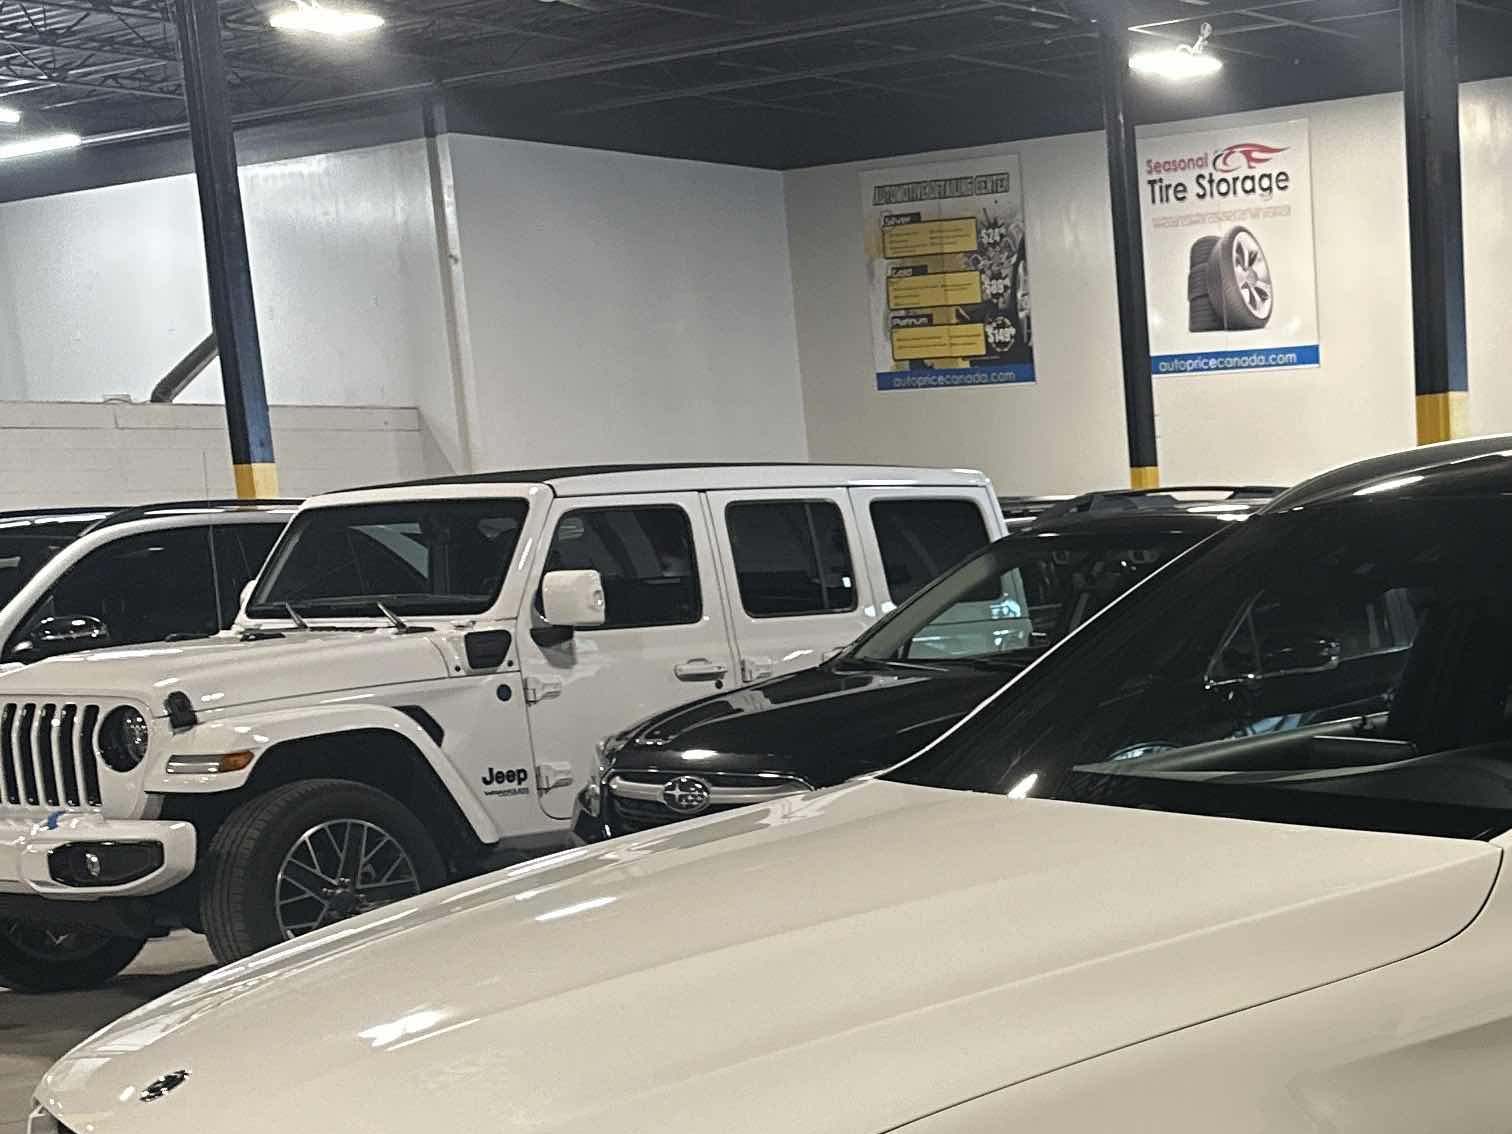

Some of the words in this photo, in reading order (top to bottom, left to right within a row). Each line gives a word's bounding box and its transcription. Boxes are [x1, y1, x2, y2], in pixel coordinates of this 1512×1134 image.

[1145, 153, 1209, 174] Seasonal
[1149, 178, 1188, 205] Tire
[1195, 171, 1290, 201] Storage
[1159, 352, 1296, 374] autopricecanada.com
[481, 767, 528, 786] Jeep
